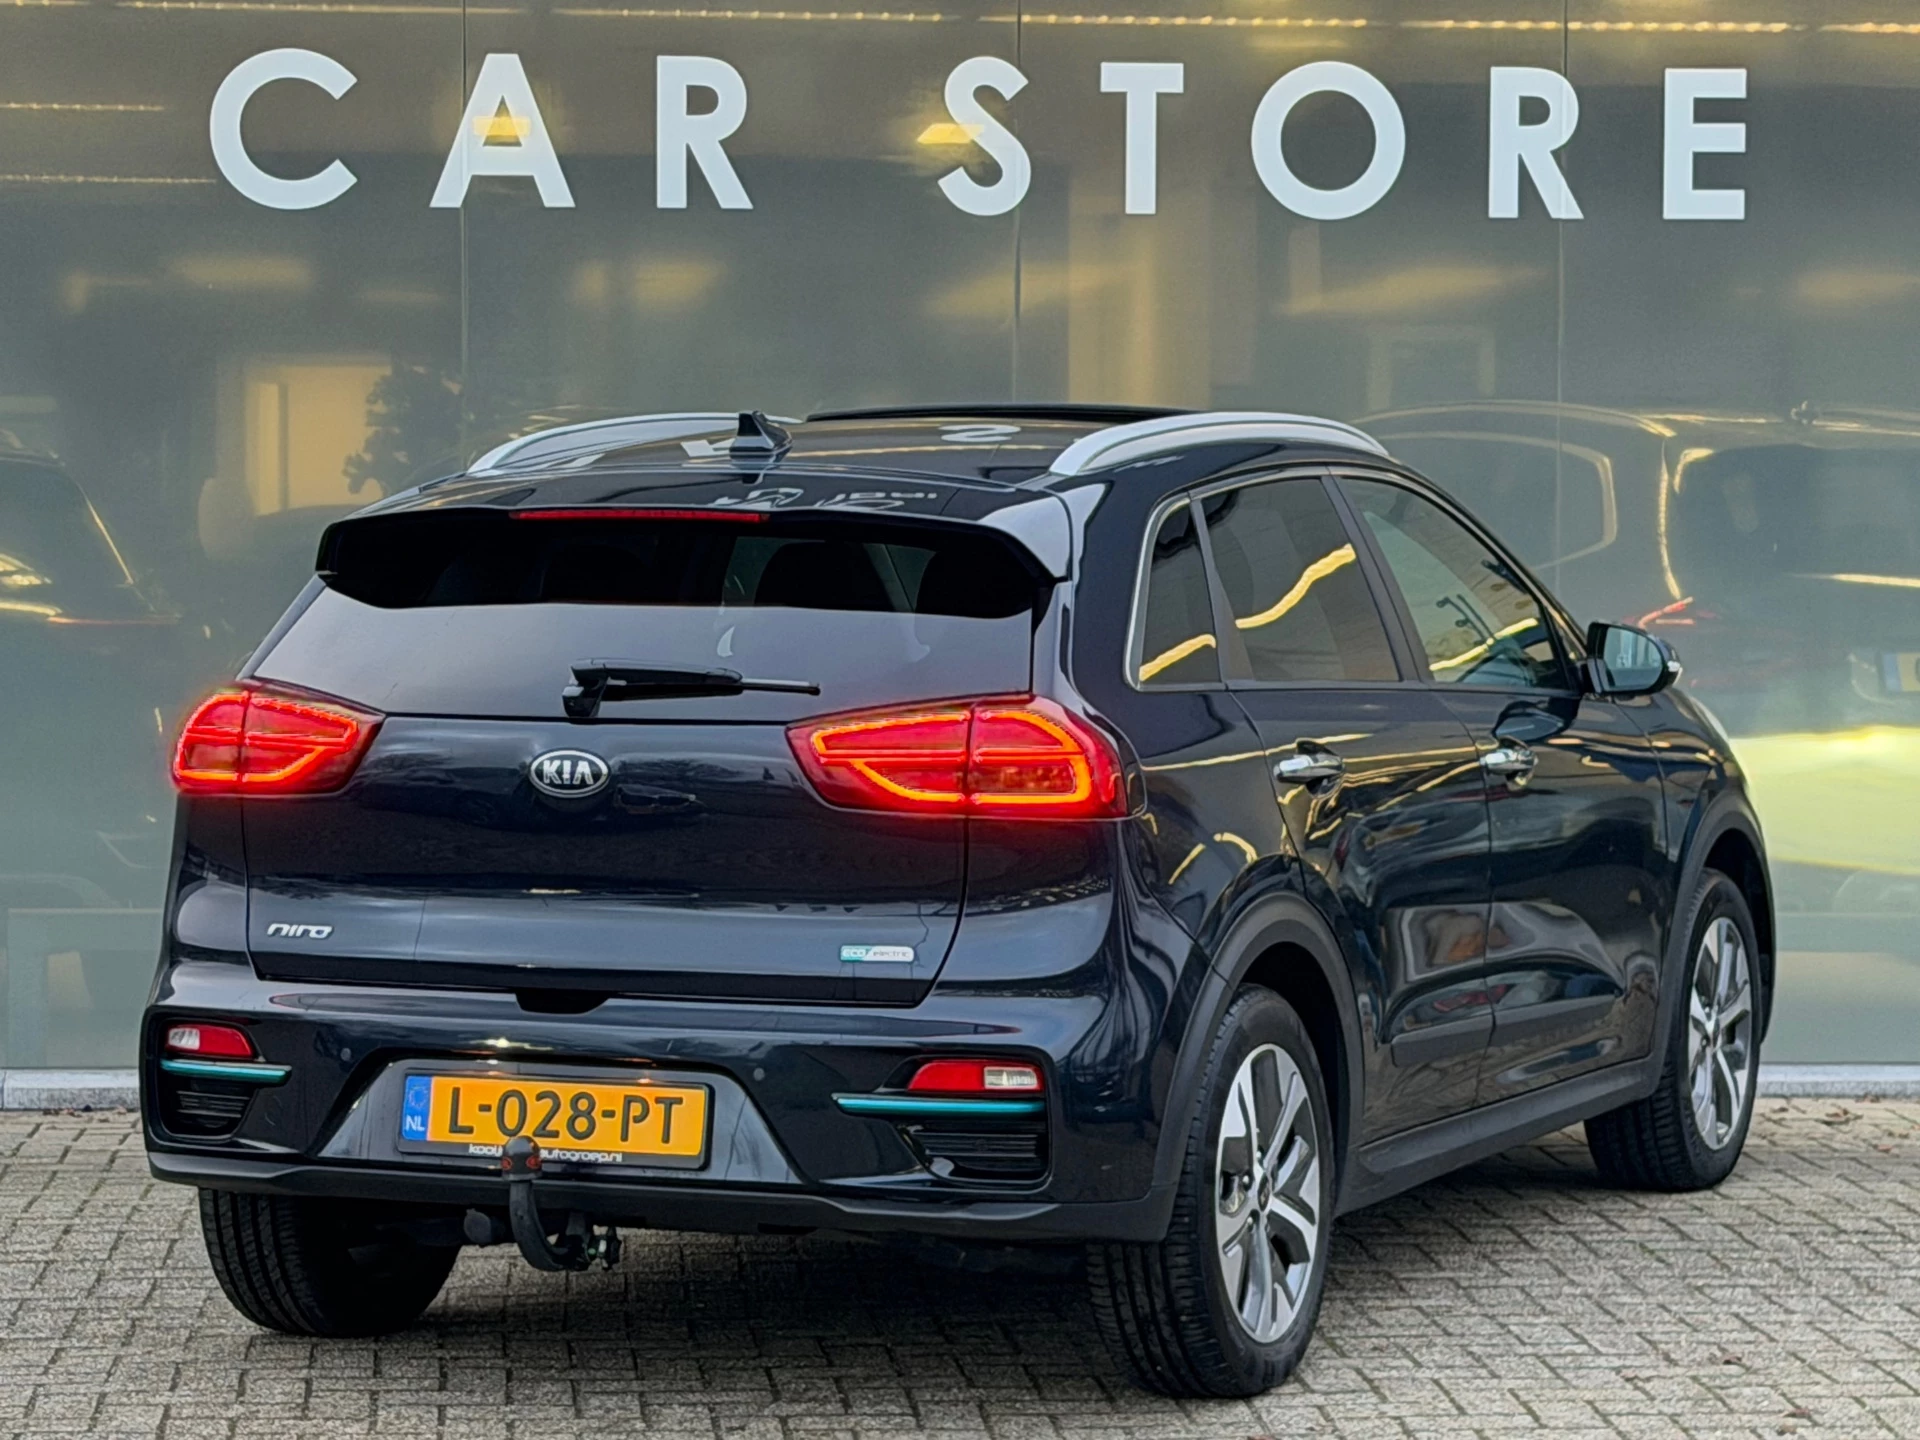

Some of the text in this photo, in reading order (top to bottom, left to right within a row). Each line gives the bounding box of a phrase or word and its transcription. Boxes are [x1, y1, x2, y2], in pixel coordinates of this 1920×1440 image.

[209, 47, 1748, 222] CAR STORE
[543, 759, 594, 785] KIA
[872, 949, 910, 958] electric
[405, 1115, 425, 1132] NL
[448, 1087, 684, 1144] L-028-PT
